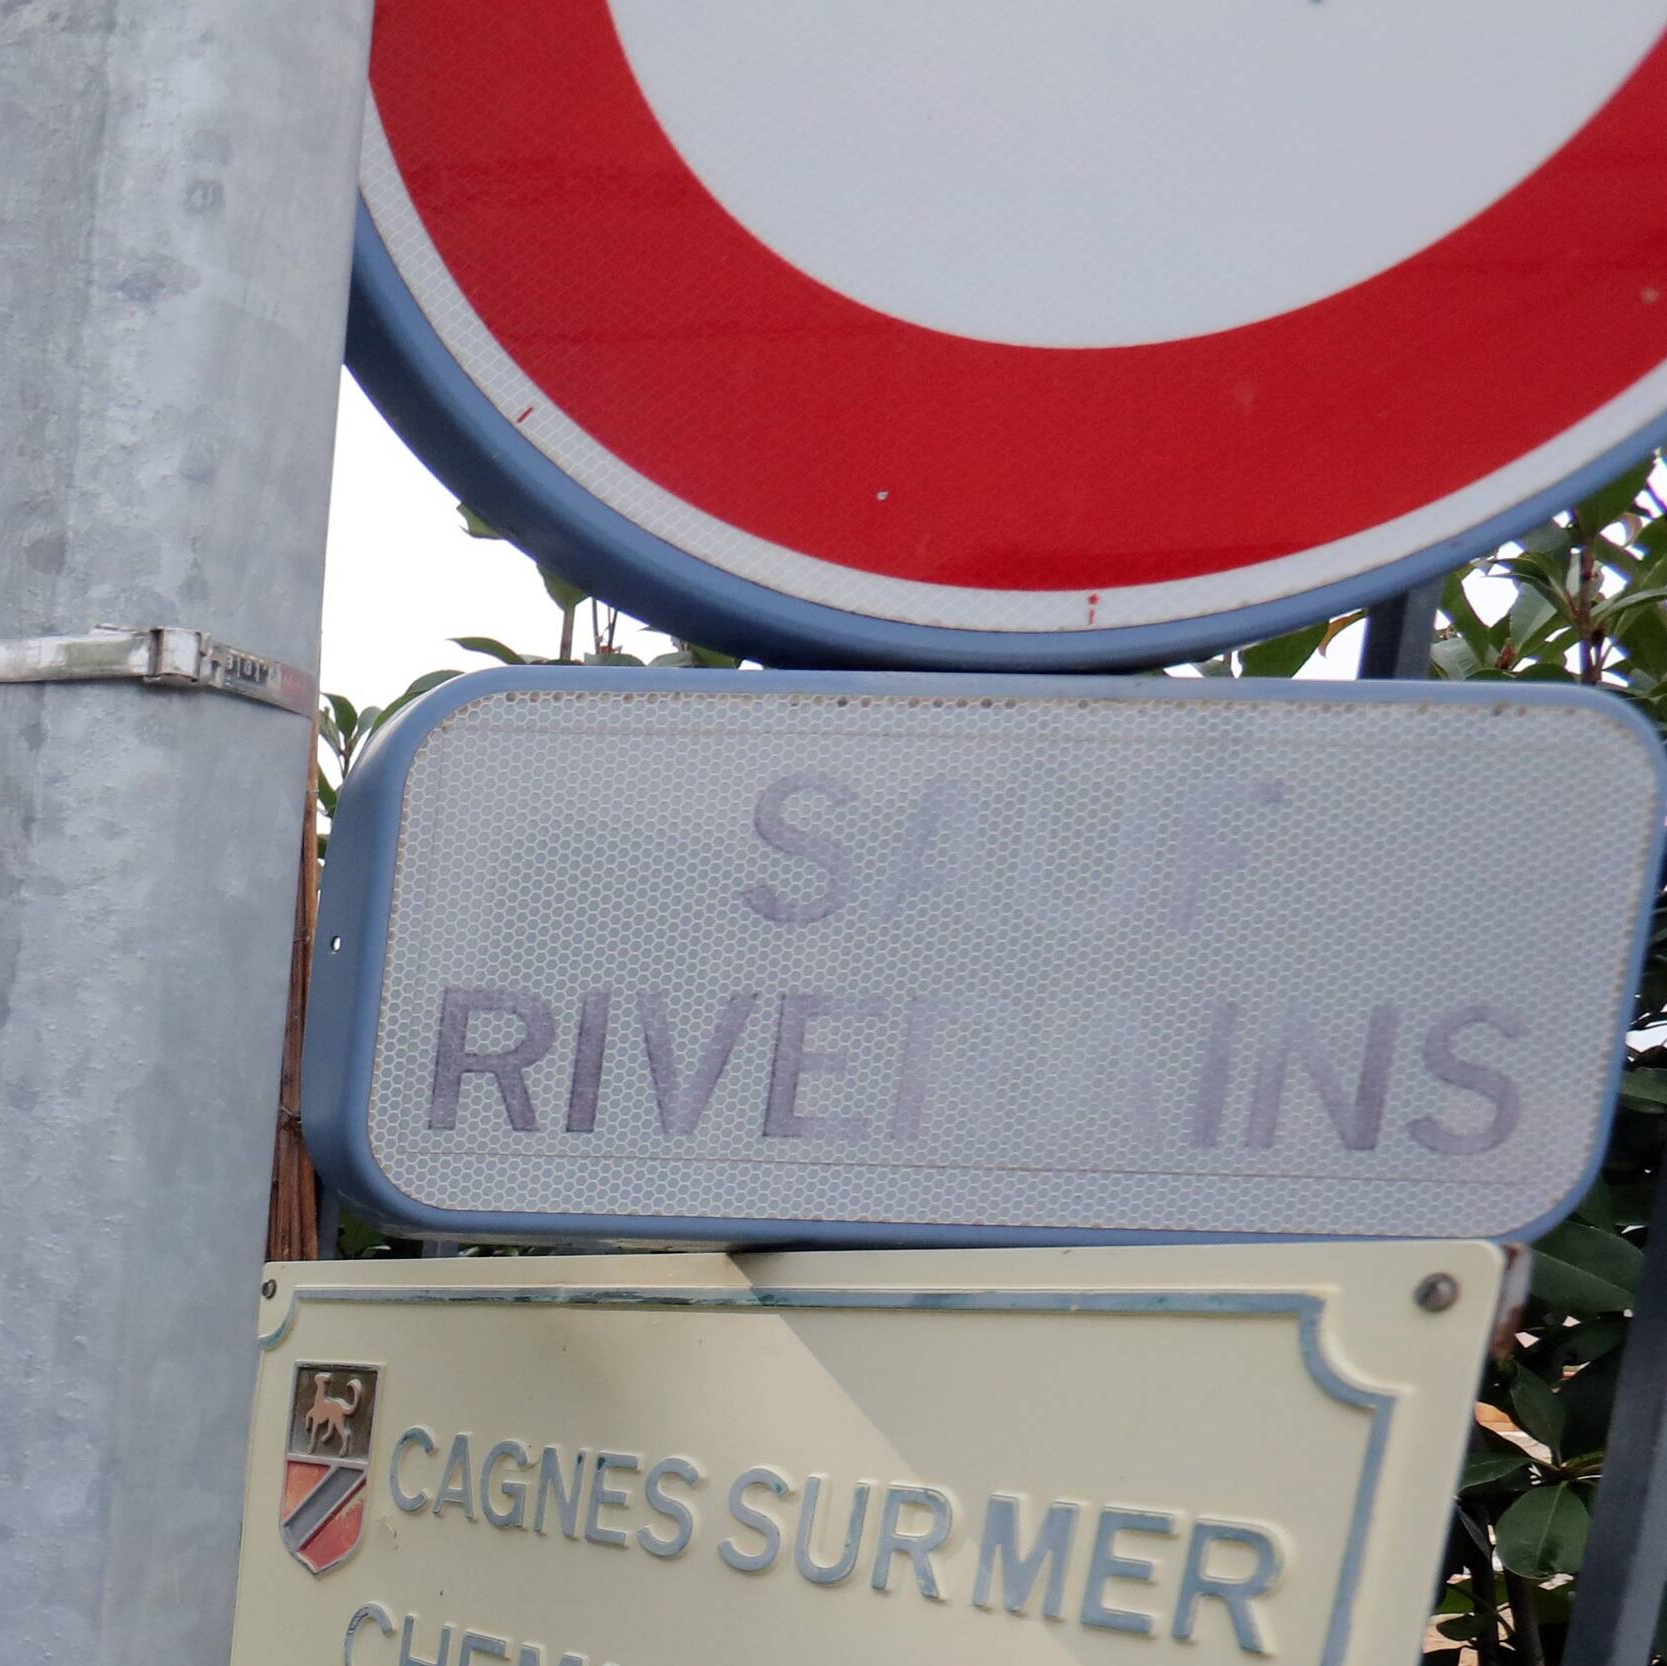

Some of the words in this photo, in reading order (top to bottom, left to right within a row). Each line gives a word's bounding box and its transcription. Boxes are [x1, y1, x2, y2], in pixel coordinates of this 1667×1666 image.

[427, 985, 1523, 1156] RIVEINS
[388, 1425, 703, 1558] CAGNES
[718, 1464, 954, 1602] SUR
[970, 1492, 1283, 1655] MER
